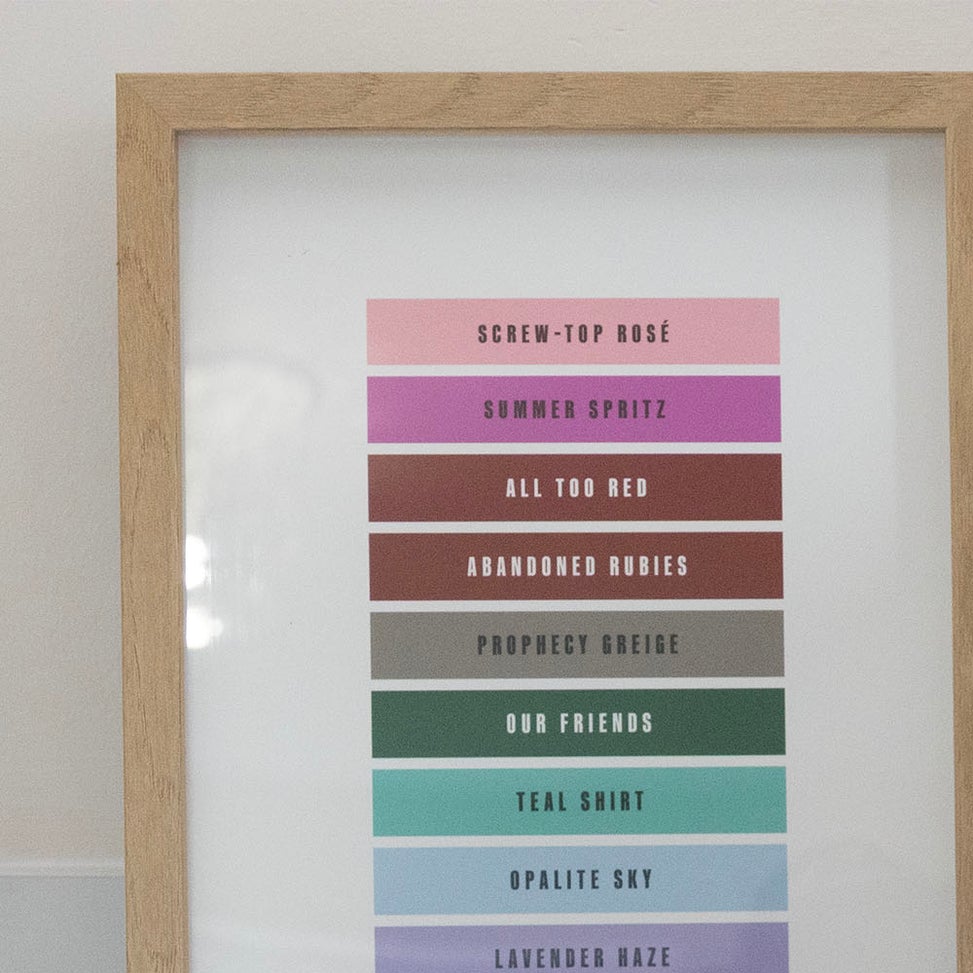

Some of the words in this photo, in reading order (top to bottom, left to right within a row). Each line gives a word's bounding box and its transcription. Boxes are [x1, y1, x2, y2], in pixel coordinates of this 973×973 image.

[477, 323, 604, 344] SCREW-TOP
[617, 319, 670, 344] ROSÉ
[483, 399, 576, 420] SUMMER
[588, 399, 667, 420] SPRITZ
[505, 477, 543, 498] ALL
[555, 477, 595, 498] TOO
[608, 477, 648, 498] RED
[467, 555, 597, 578] ABANDONED
[609, 555, 688, 577] RUBIES
[477, 634, 588, 656] PROPHECY
[601, 633, 680, 655] GREIGE
[506, 712, 547, 734] OUR
[560, 711, 653, 734] FRIENDS
[515, 791, 567, 813] TEAL
[580, 790, 645, 812] SHIRT
[510, 869, 600, 891] OPALITE
[613, 868, 653, 890] SKY
[494, 947, 605, 969] LAVENDER
[617, 946, 671, 968] HAZE
